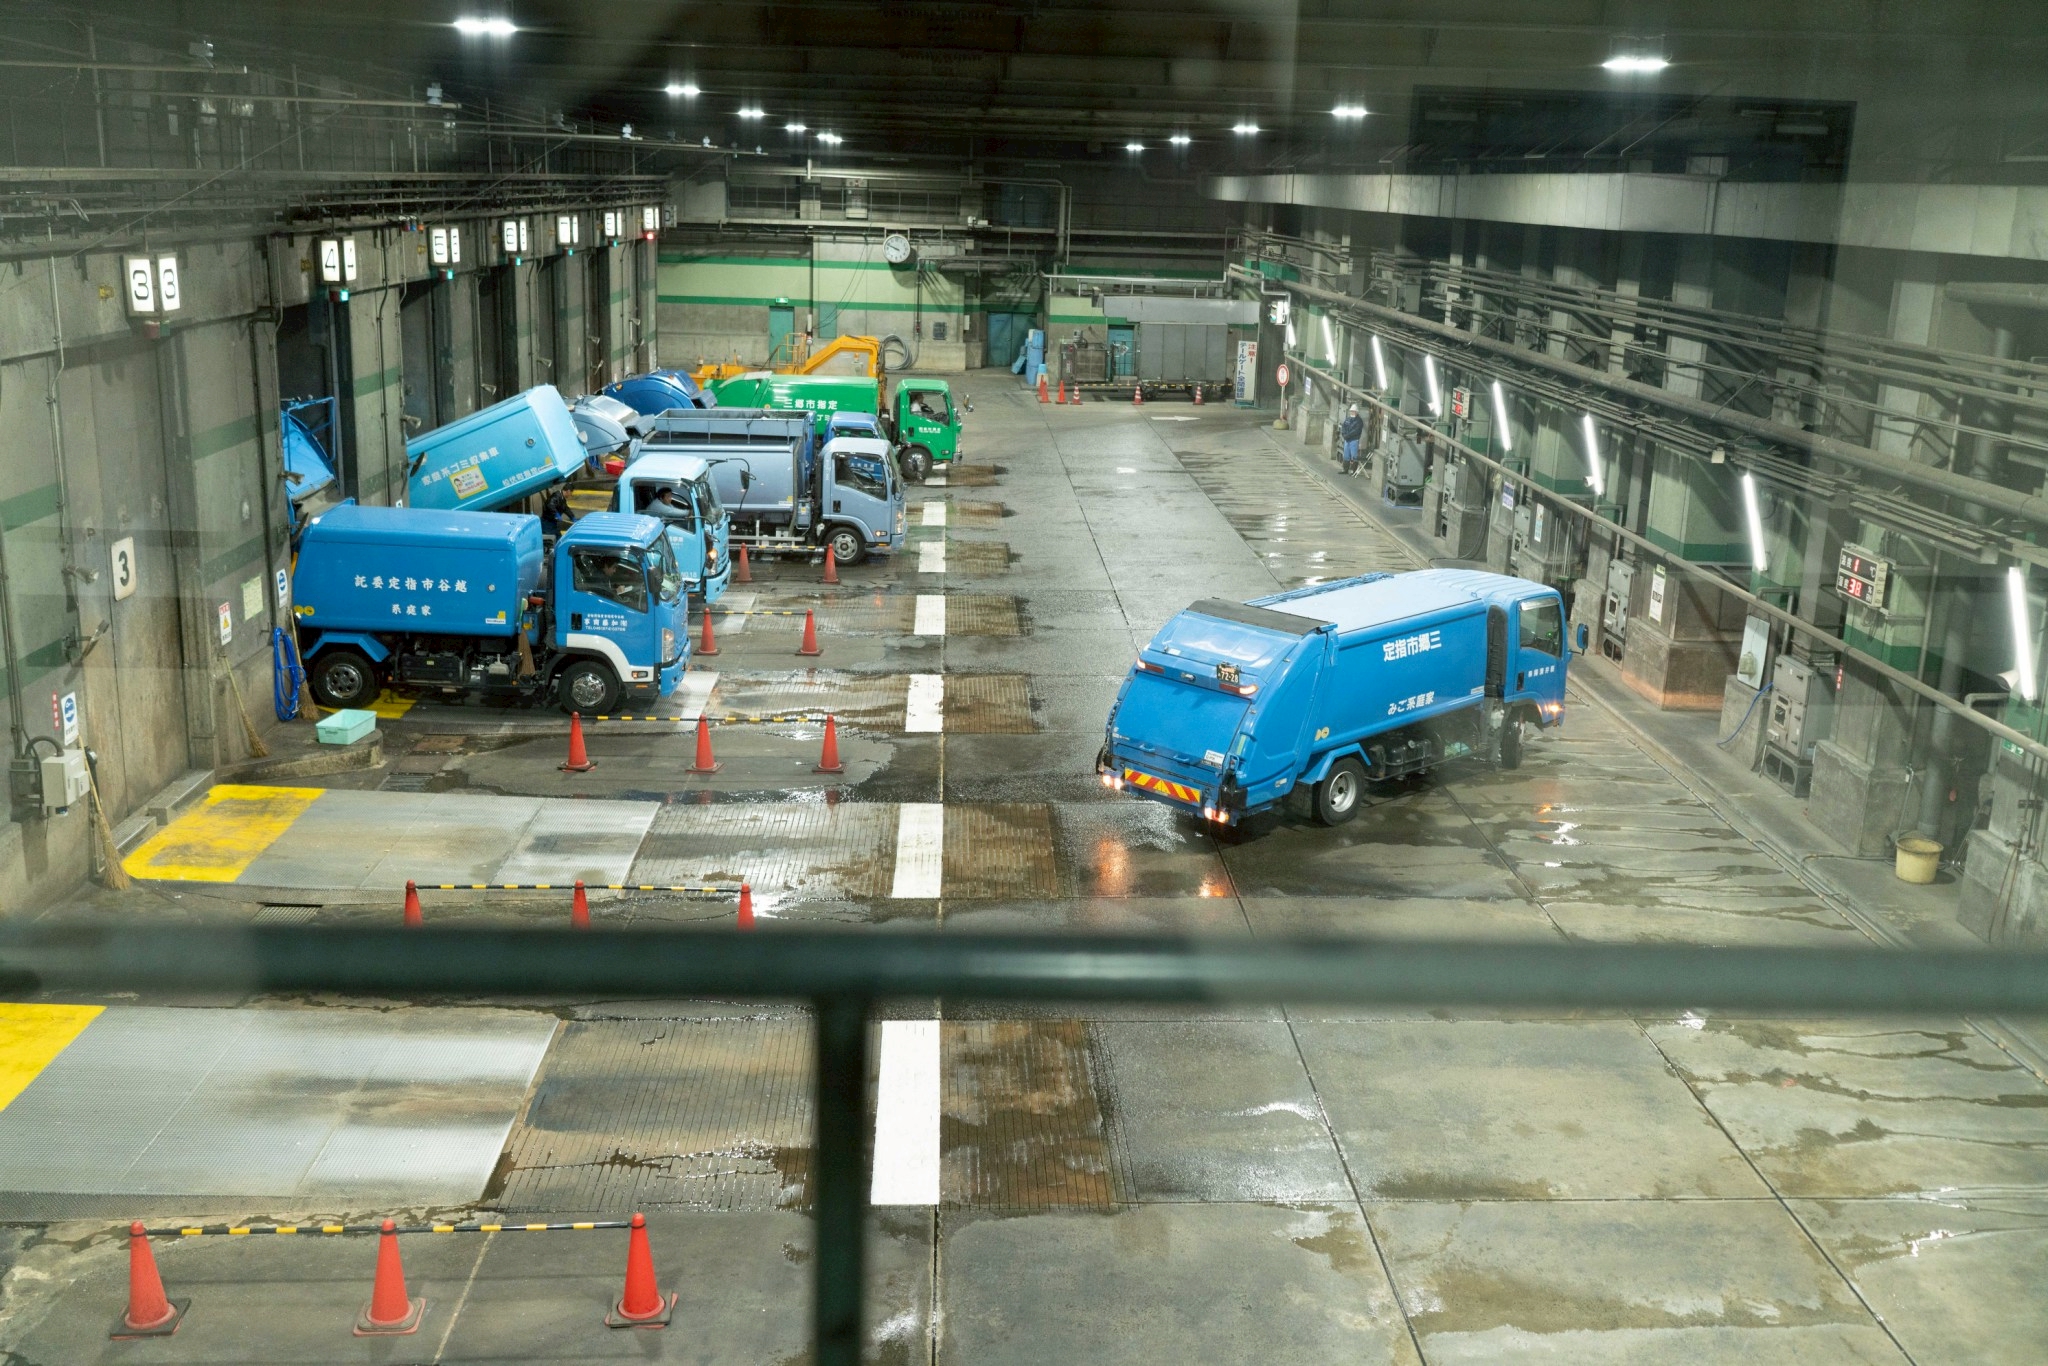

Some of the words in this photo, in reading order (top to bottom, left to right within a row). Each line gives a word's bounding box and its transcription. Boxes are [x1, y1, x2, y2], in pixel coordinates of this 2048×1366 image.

[434, 235, 444, 256] 5
[325, 248, 337, 272] 4
[132, 269, 149, 300] 3
[163, 268, 176, 299] 3
[783, 398, 838, 411] 三郷市指定
[118, 550, 130, 587] 3
[1221, 671, 1239, 683] 72-28
